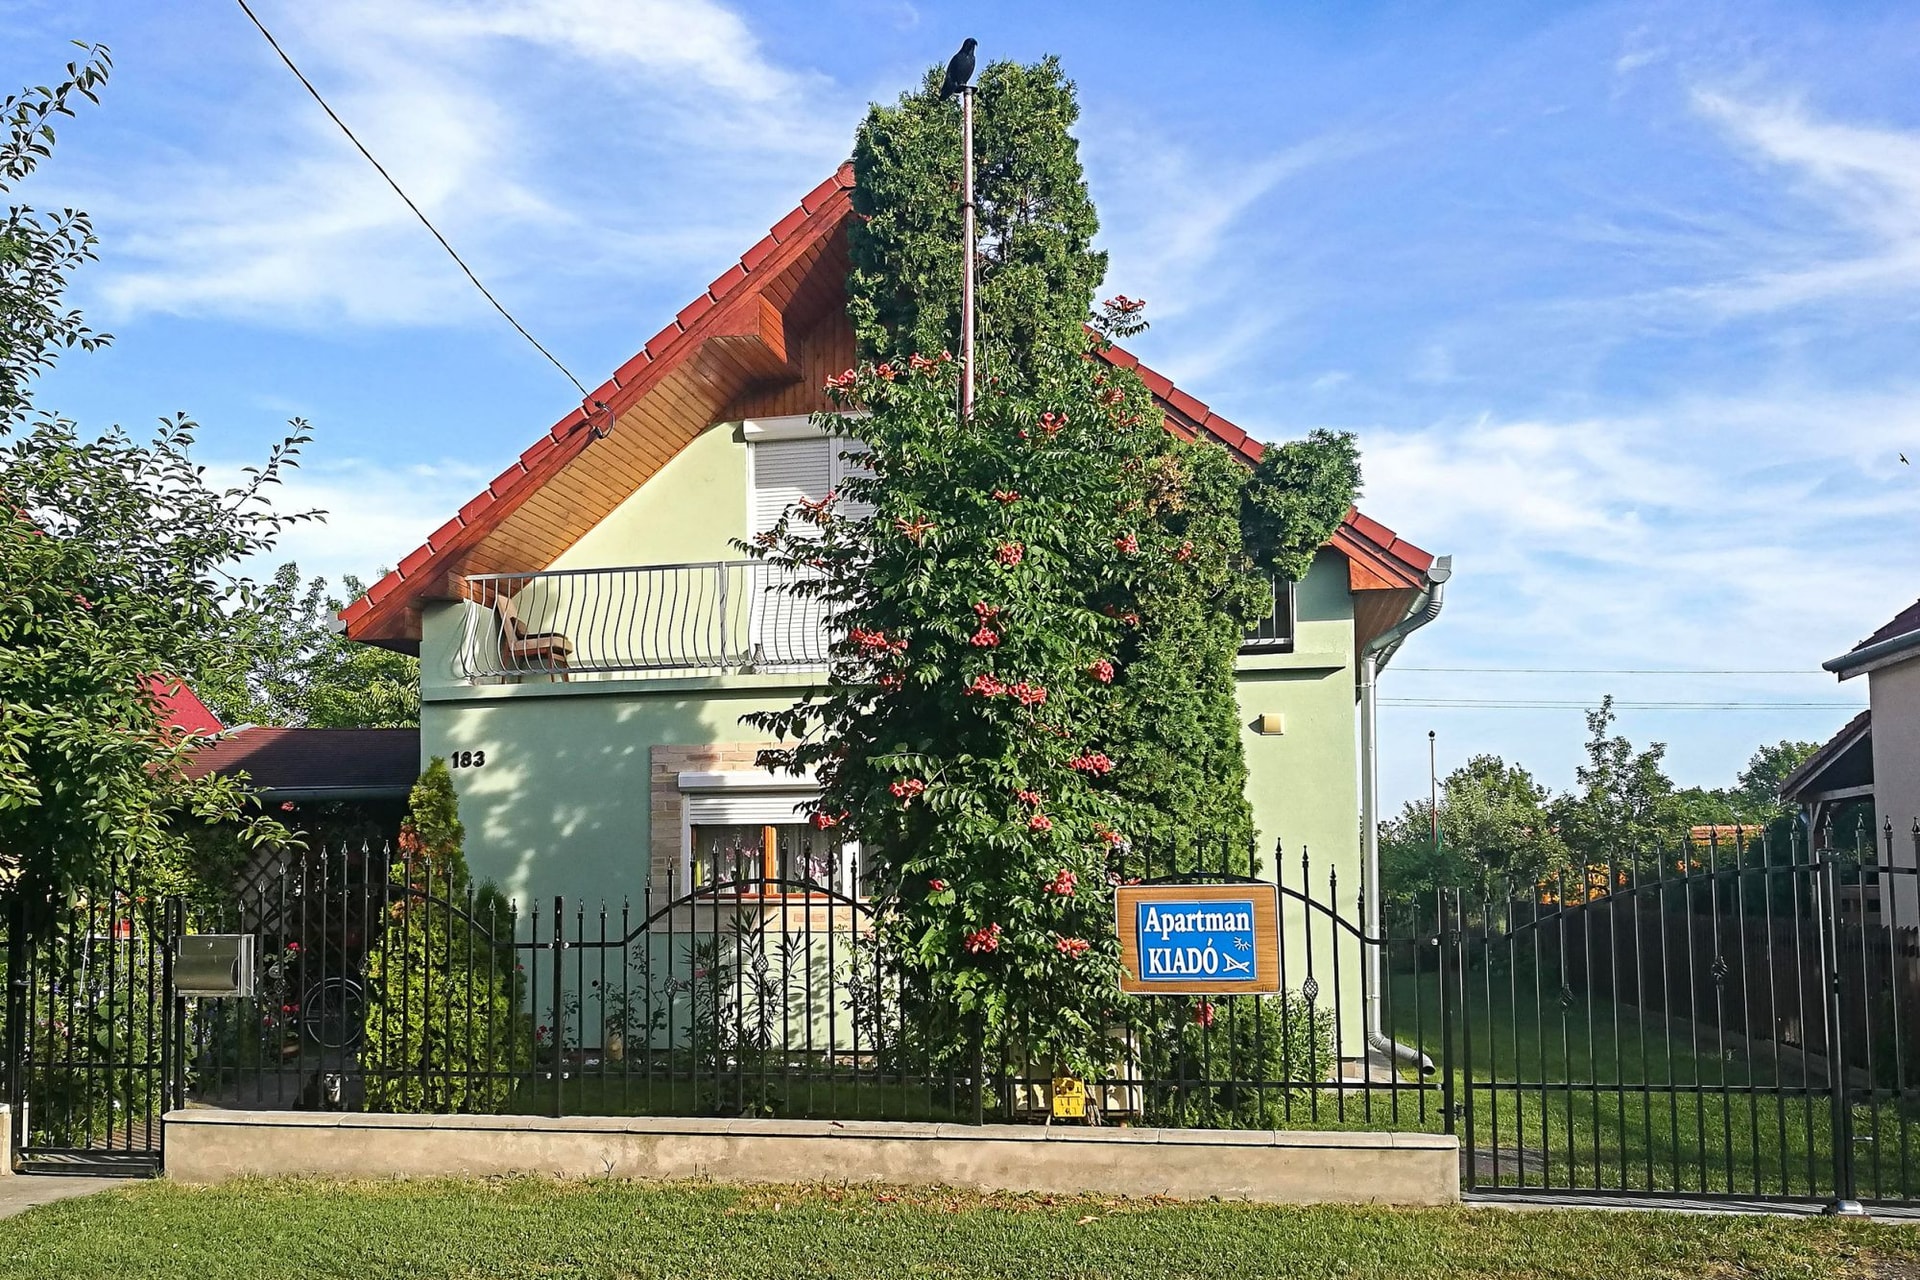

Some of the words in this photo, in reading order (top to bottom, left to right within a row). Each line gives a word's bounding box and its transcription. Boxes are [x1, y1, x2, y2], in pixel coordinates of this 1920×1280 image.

[451, 750, 485, 769] 183
[1144, 907, 1250, 940] Apartman
[1148, 938, 1219, 975] KIADÓ
